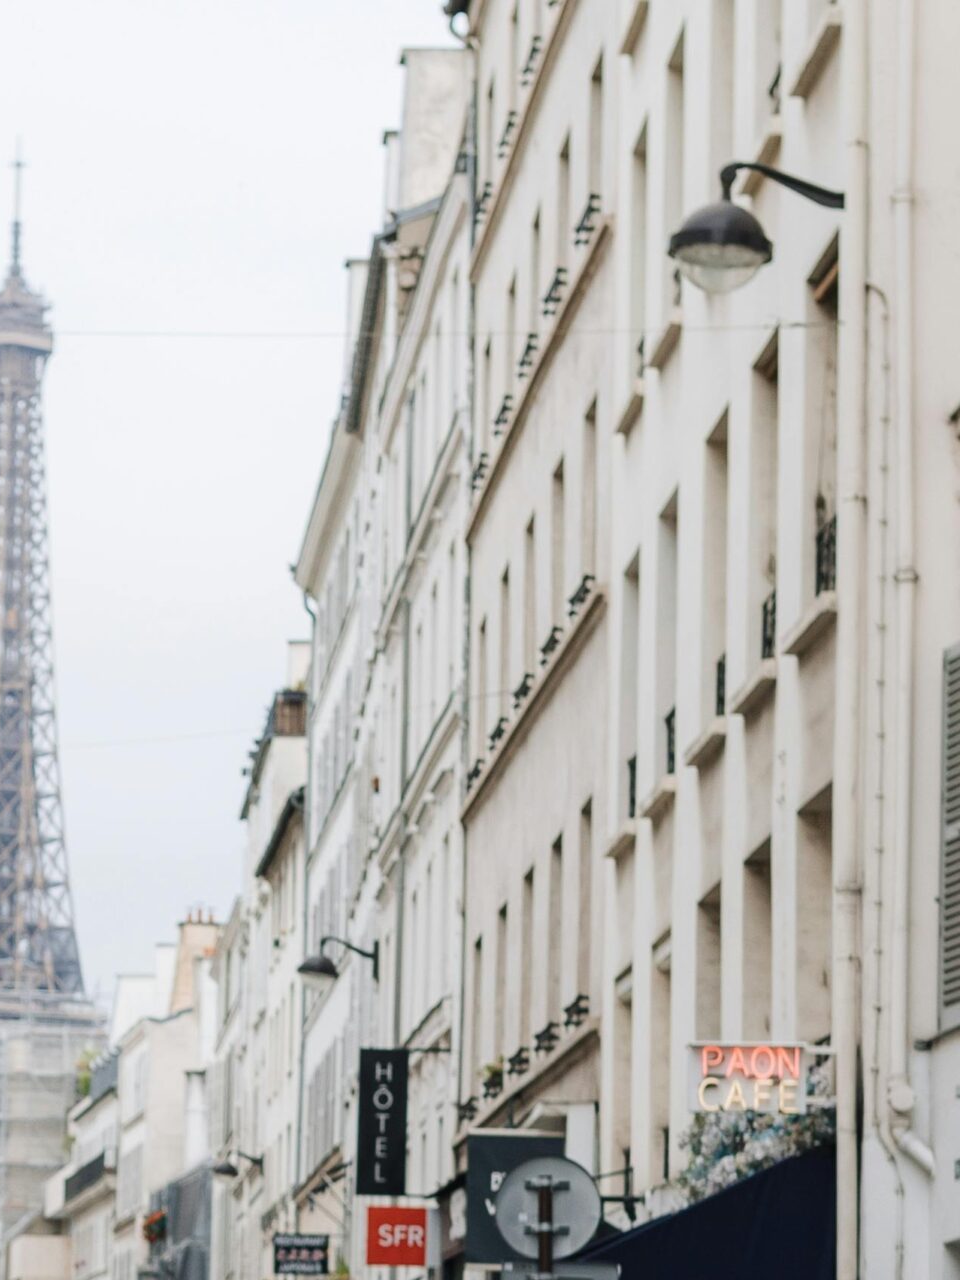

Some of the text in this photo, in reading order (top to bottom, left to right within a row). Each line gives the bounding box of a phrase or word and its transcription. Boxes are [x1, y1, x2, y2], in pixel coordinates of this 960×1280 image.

[702, 1045, 800, 1079] PAON
[698, 1077, 801, 1114] CAFE
[372, 1061, 394, 1184] HÔTEL
[378, 1223, 424, 1249] SFR
